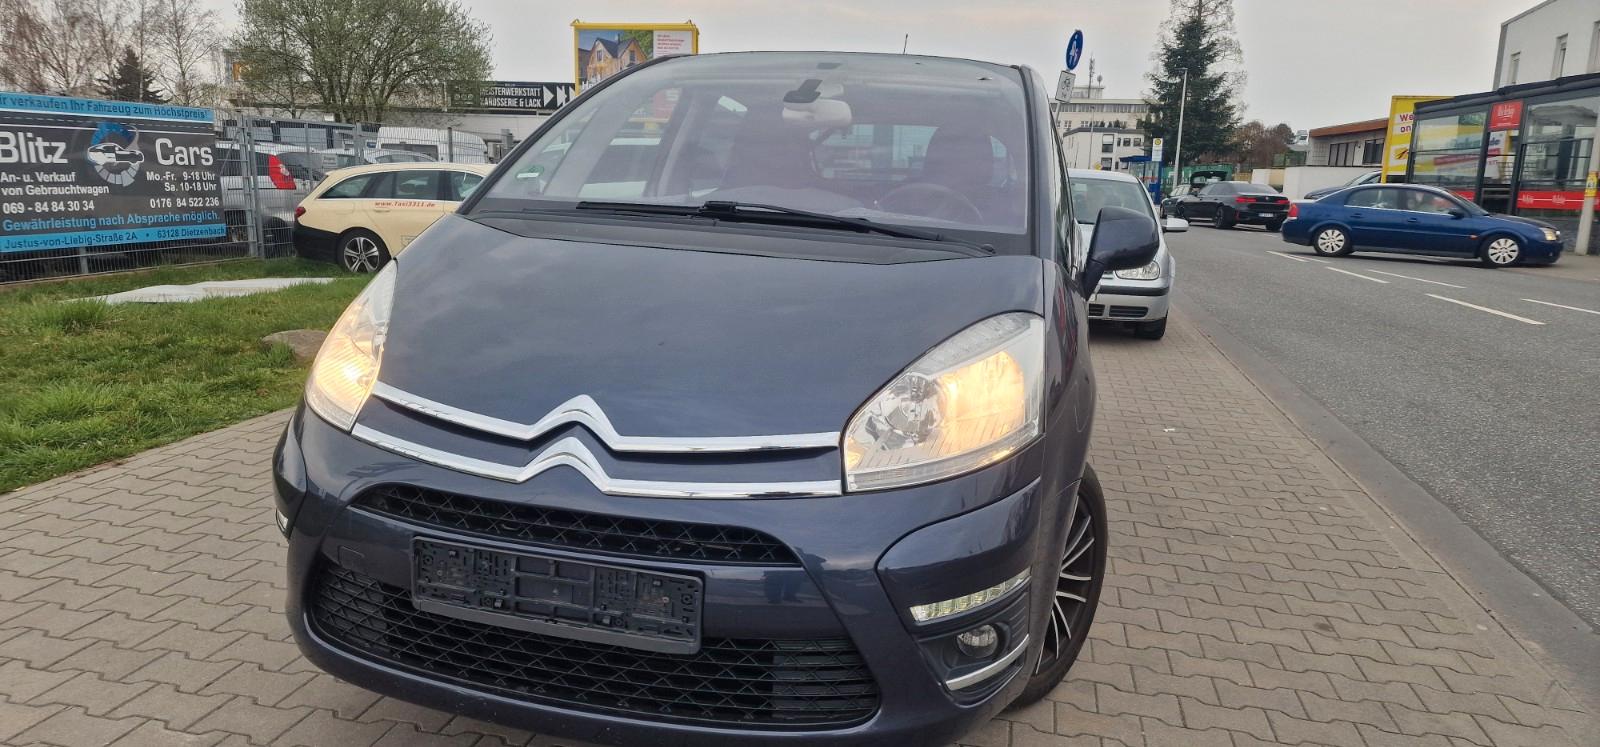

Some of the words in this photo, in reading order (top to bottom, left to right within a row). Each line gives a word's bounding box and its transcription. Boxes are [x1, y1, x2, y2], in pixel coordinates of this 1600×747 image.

[10, 96, 67, 110] verkaufen
[70, 99, 84, 111] Ihr
[87, 101, 131, 116] Fahrzeug
[133, 105, 152, 115] zum
[525, 98, 541, 107] LACK
[0, 131, 68, 164] Blitz
[155, 137, 214, 166] Cars
[1, 172, 21, 183] An-
[23, 174, 33, 182] u.
[35, 171, 76, 183] Verkauf
[146, 171, 177, 181] Mo.-Fr.
[182, 172, 201, 181] 9-18
[201, 172, 215, 181] Uhr
[1, 186, 24, 196] von
[27, 184, 110, 196] Gebrauchtwagen
[164, 182, 178, 191] Sa.
[179, 182, 202, 191] 10-18
[203, 182, 217, 191] Uhr
[3, 203, 25, 214] 069
[35, 202, 49, 212] 84
[51, 201, 65, 212] 84
[67, 201, 81, 211] 30
[82, 200, 95, 210] 34
[150, 199, 172, 208] 0176
[176, 198, 188, 207] 84
[189, 198, 204, 207] 522
[205, 197, 219, 207] 236
[3, 216, 97, 231] Gewährleistung
[99, 215, 124, 226] nach
[127, 213, 180, 226] Absprache
[182, 211, 220, 223] möglich.
[125, 232, 138, 241] 2A
[157, 228, 180, 238] 63128
[181, 227, 225, 237] Dietzenbach
